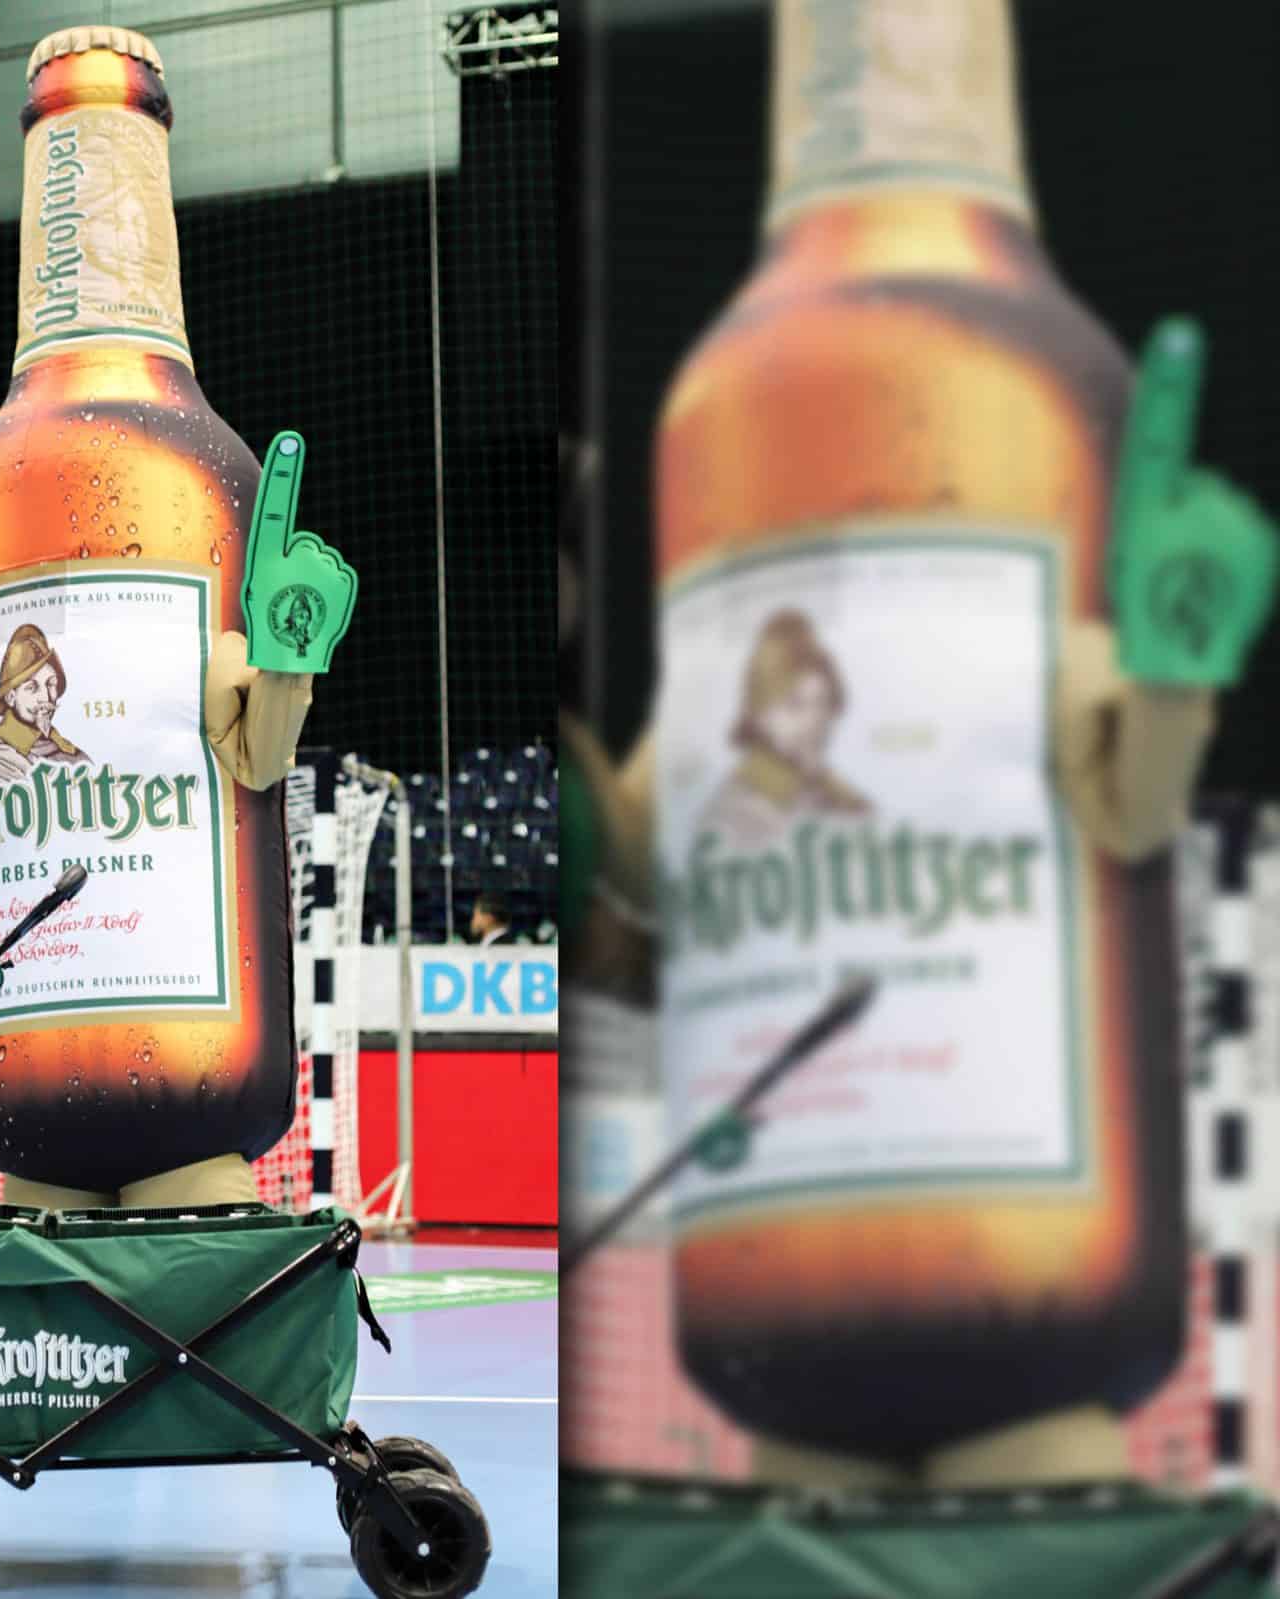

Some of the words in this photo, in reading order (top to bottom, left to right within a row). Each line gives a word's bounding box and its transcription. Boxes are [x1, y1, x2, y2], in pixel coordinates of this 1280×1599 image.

[88, 591, 111, 602] AUS
[83, 700, 126, 719] 1534
[62, 854, 154, 874] PILSNER
[421, 961, 558, 1015] DKB
[48, 1394, 101, 1409] PILSNER
